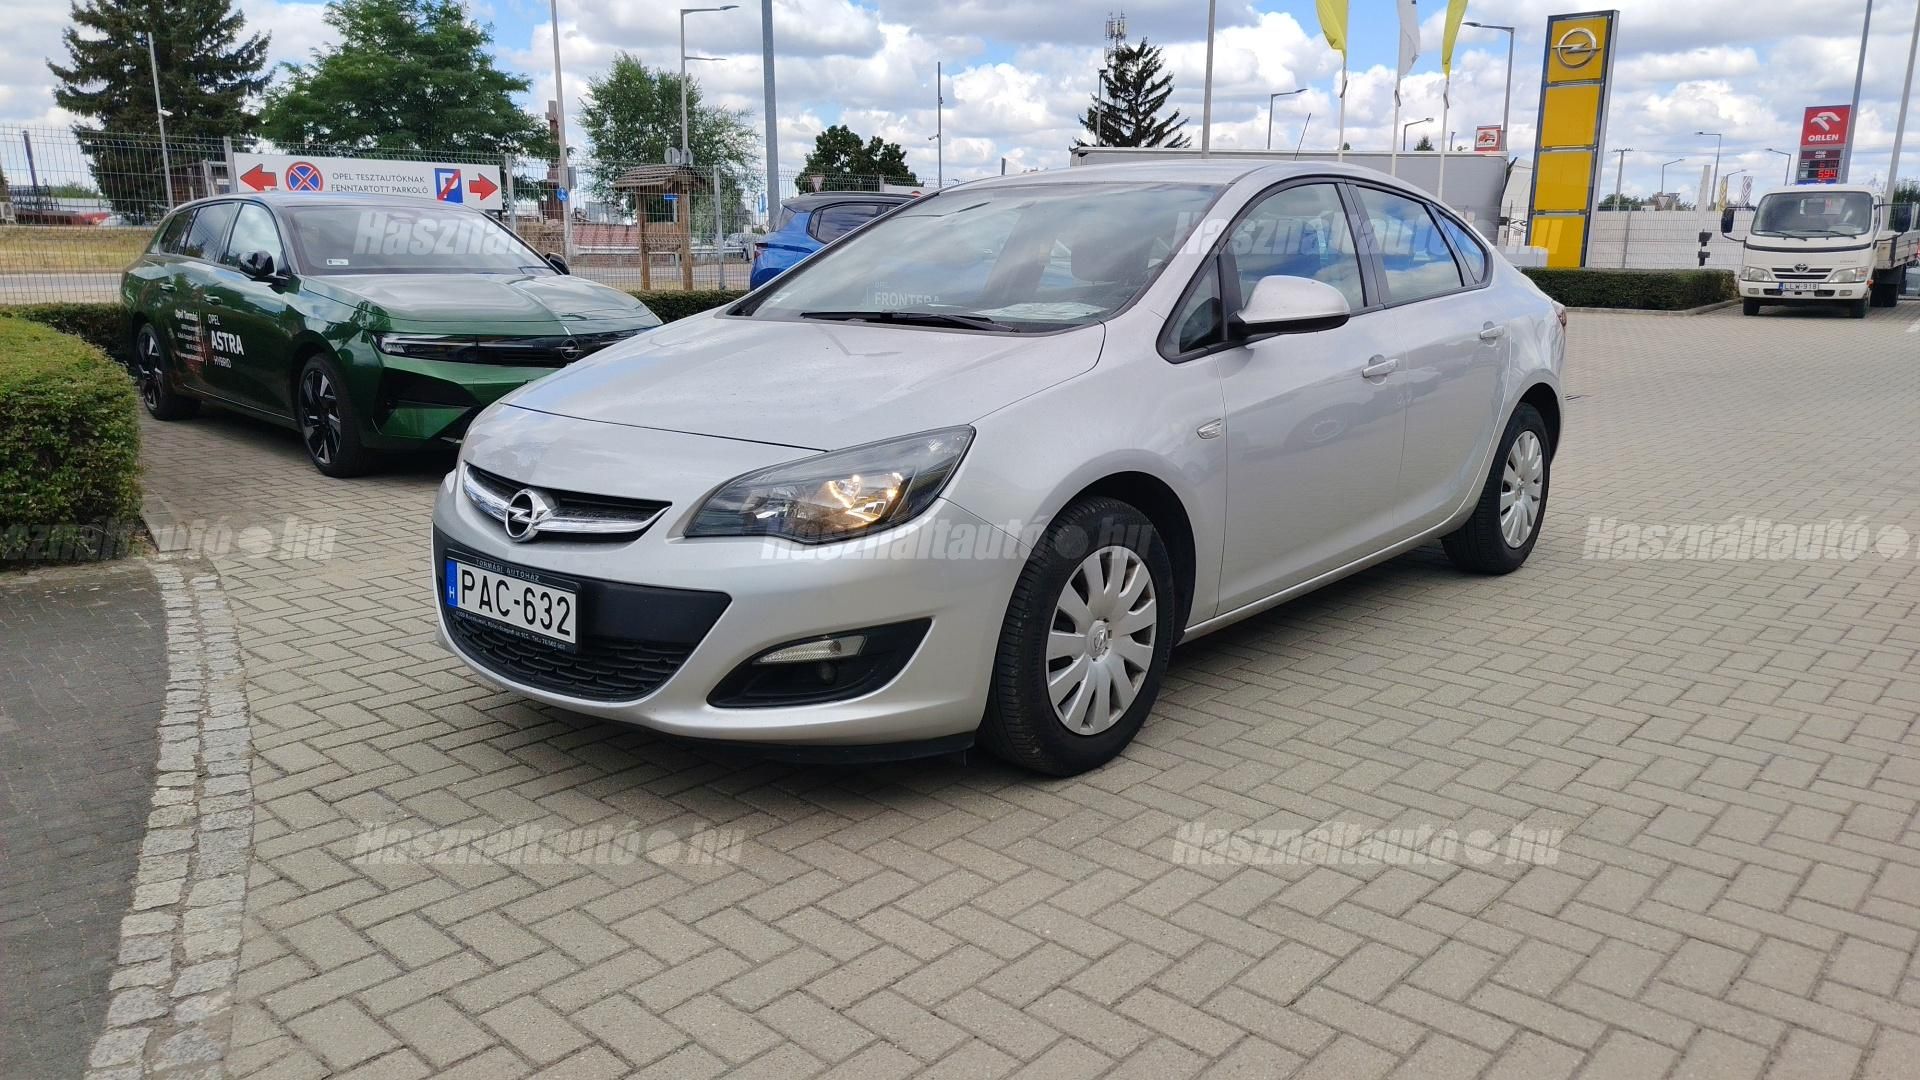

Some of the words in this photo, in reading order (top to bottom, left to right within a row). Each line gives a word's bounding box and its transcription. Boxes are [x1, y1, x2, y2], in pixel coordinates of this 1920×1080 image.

[1808, 134, 1839, 142] ORLEN
[332, 172, 354, 181] OPEL
[355, 173, 425, 183] TESZTAUTÓKNAK
[331, 184, 391, 193] FENNTARTOTT
[392, 185, 429, 194] PARKOLÓ
[208, 314, 221, 325] OPEL
[211, 330, 245, 355] ASTRA
[448, 586, 455, 599] H
[461, 569, 571, 637] PAC-632
